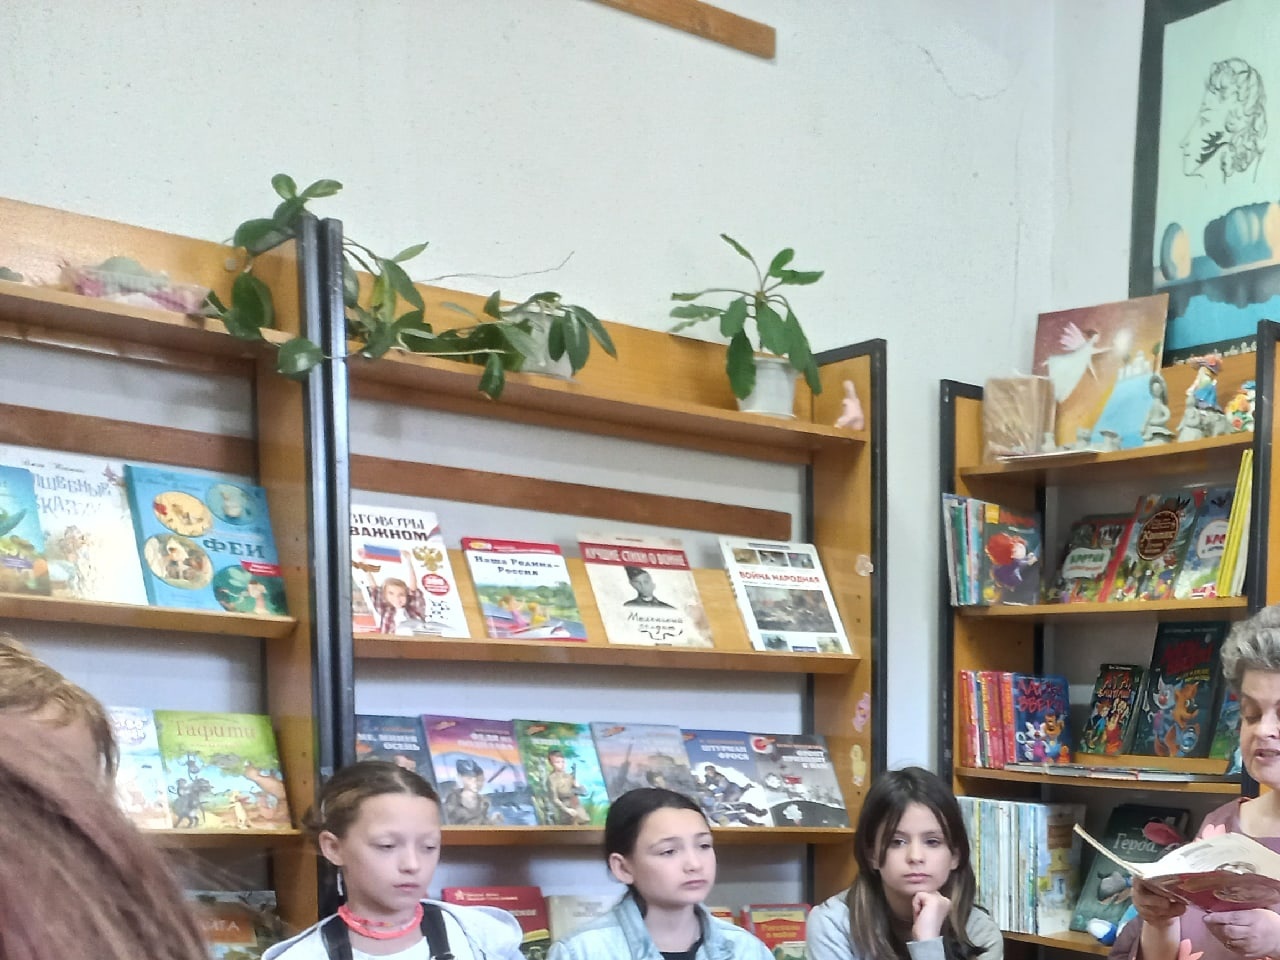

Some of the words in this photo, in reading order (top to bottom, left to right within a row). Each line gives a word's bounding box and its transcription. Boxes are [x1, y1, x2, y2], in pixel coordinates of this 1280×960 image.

[202, 538, 266, 559] ФЕИ
[739, 571, 770, 581] ВОЙНА
[771, 573, 820, 584] НАРОДНАЯ
